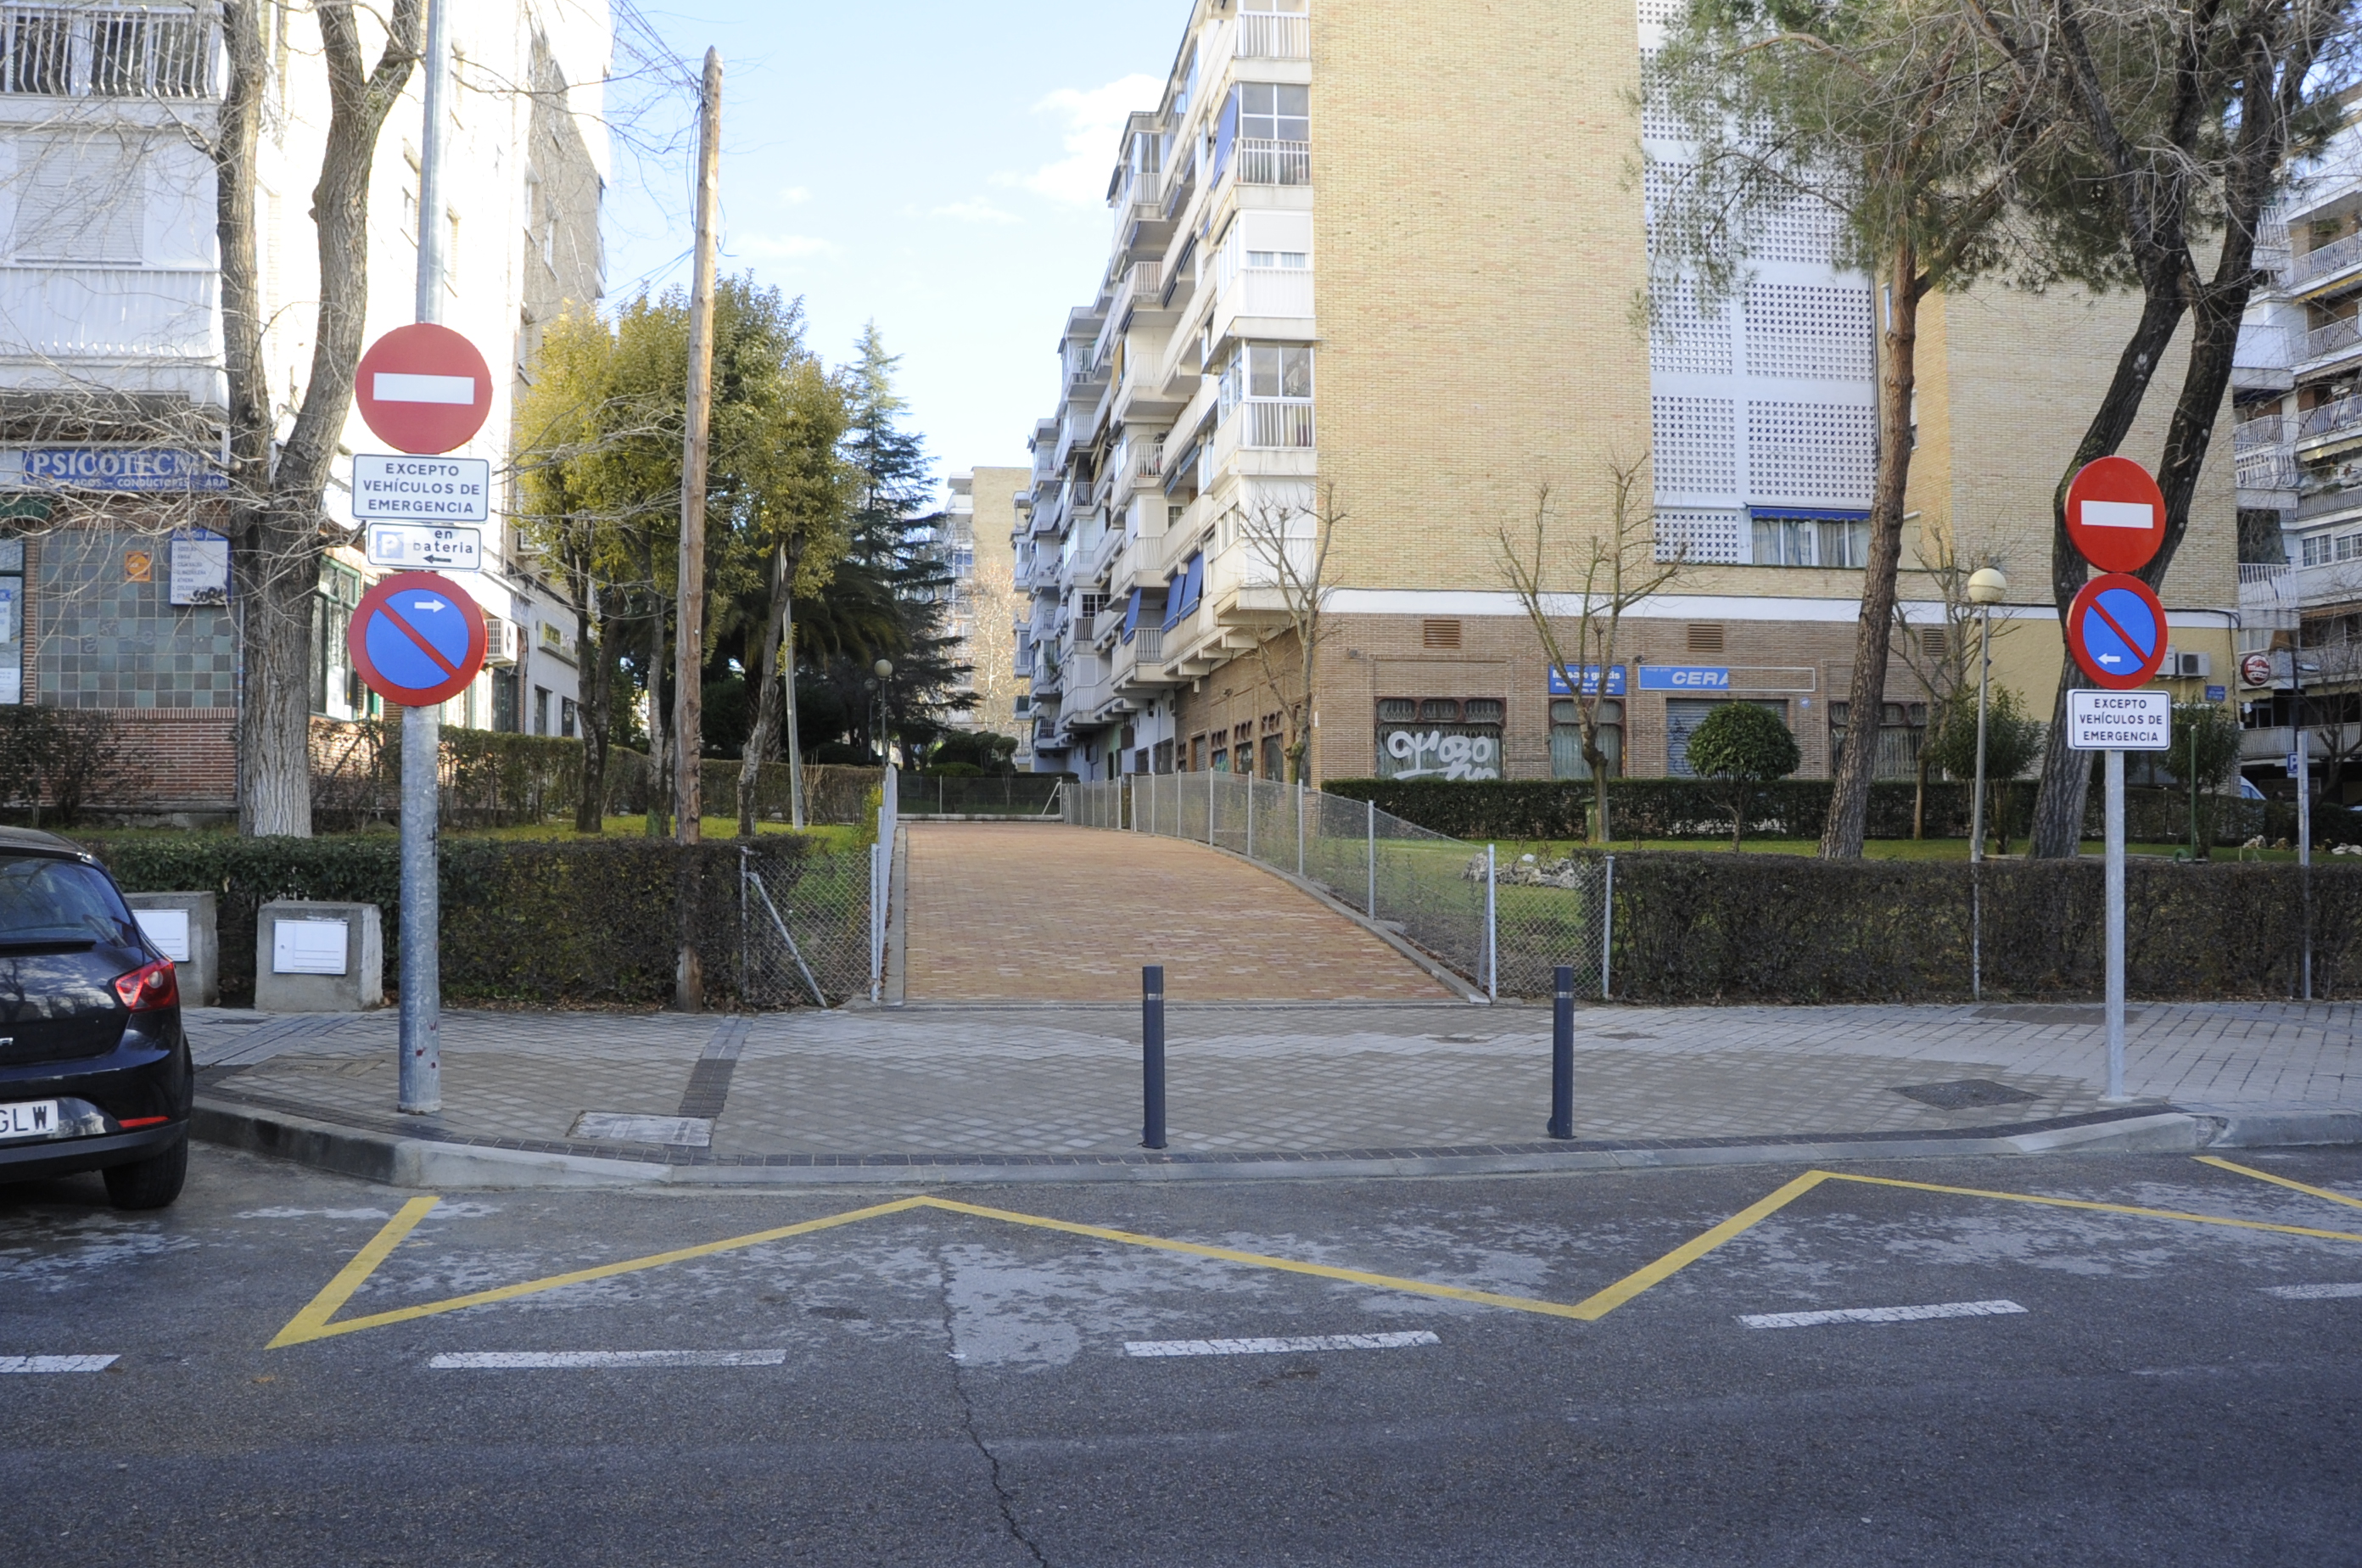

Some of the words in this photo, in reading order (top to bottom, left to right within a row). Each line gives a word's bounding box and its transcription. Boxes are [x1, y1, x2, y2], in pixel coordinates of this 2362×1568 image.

[385, 462, 460, 477] EXCEPTO
[363, 478, 454, 494] VEHÍCULOS
[460, 484, 480, 496] DE
[367, 499, 474, 513] EMERGENCIA
[434, 529, 453, 540] en
[2094, 698, 2147, 709] EXCEPTO
[2079, 711, 2144, 725] VEHÍCULOS
[2148, 715, 2163, 725] DE
[2083, 731, 2158, 742] EMERGENCIA
